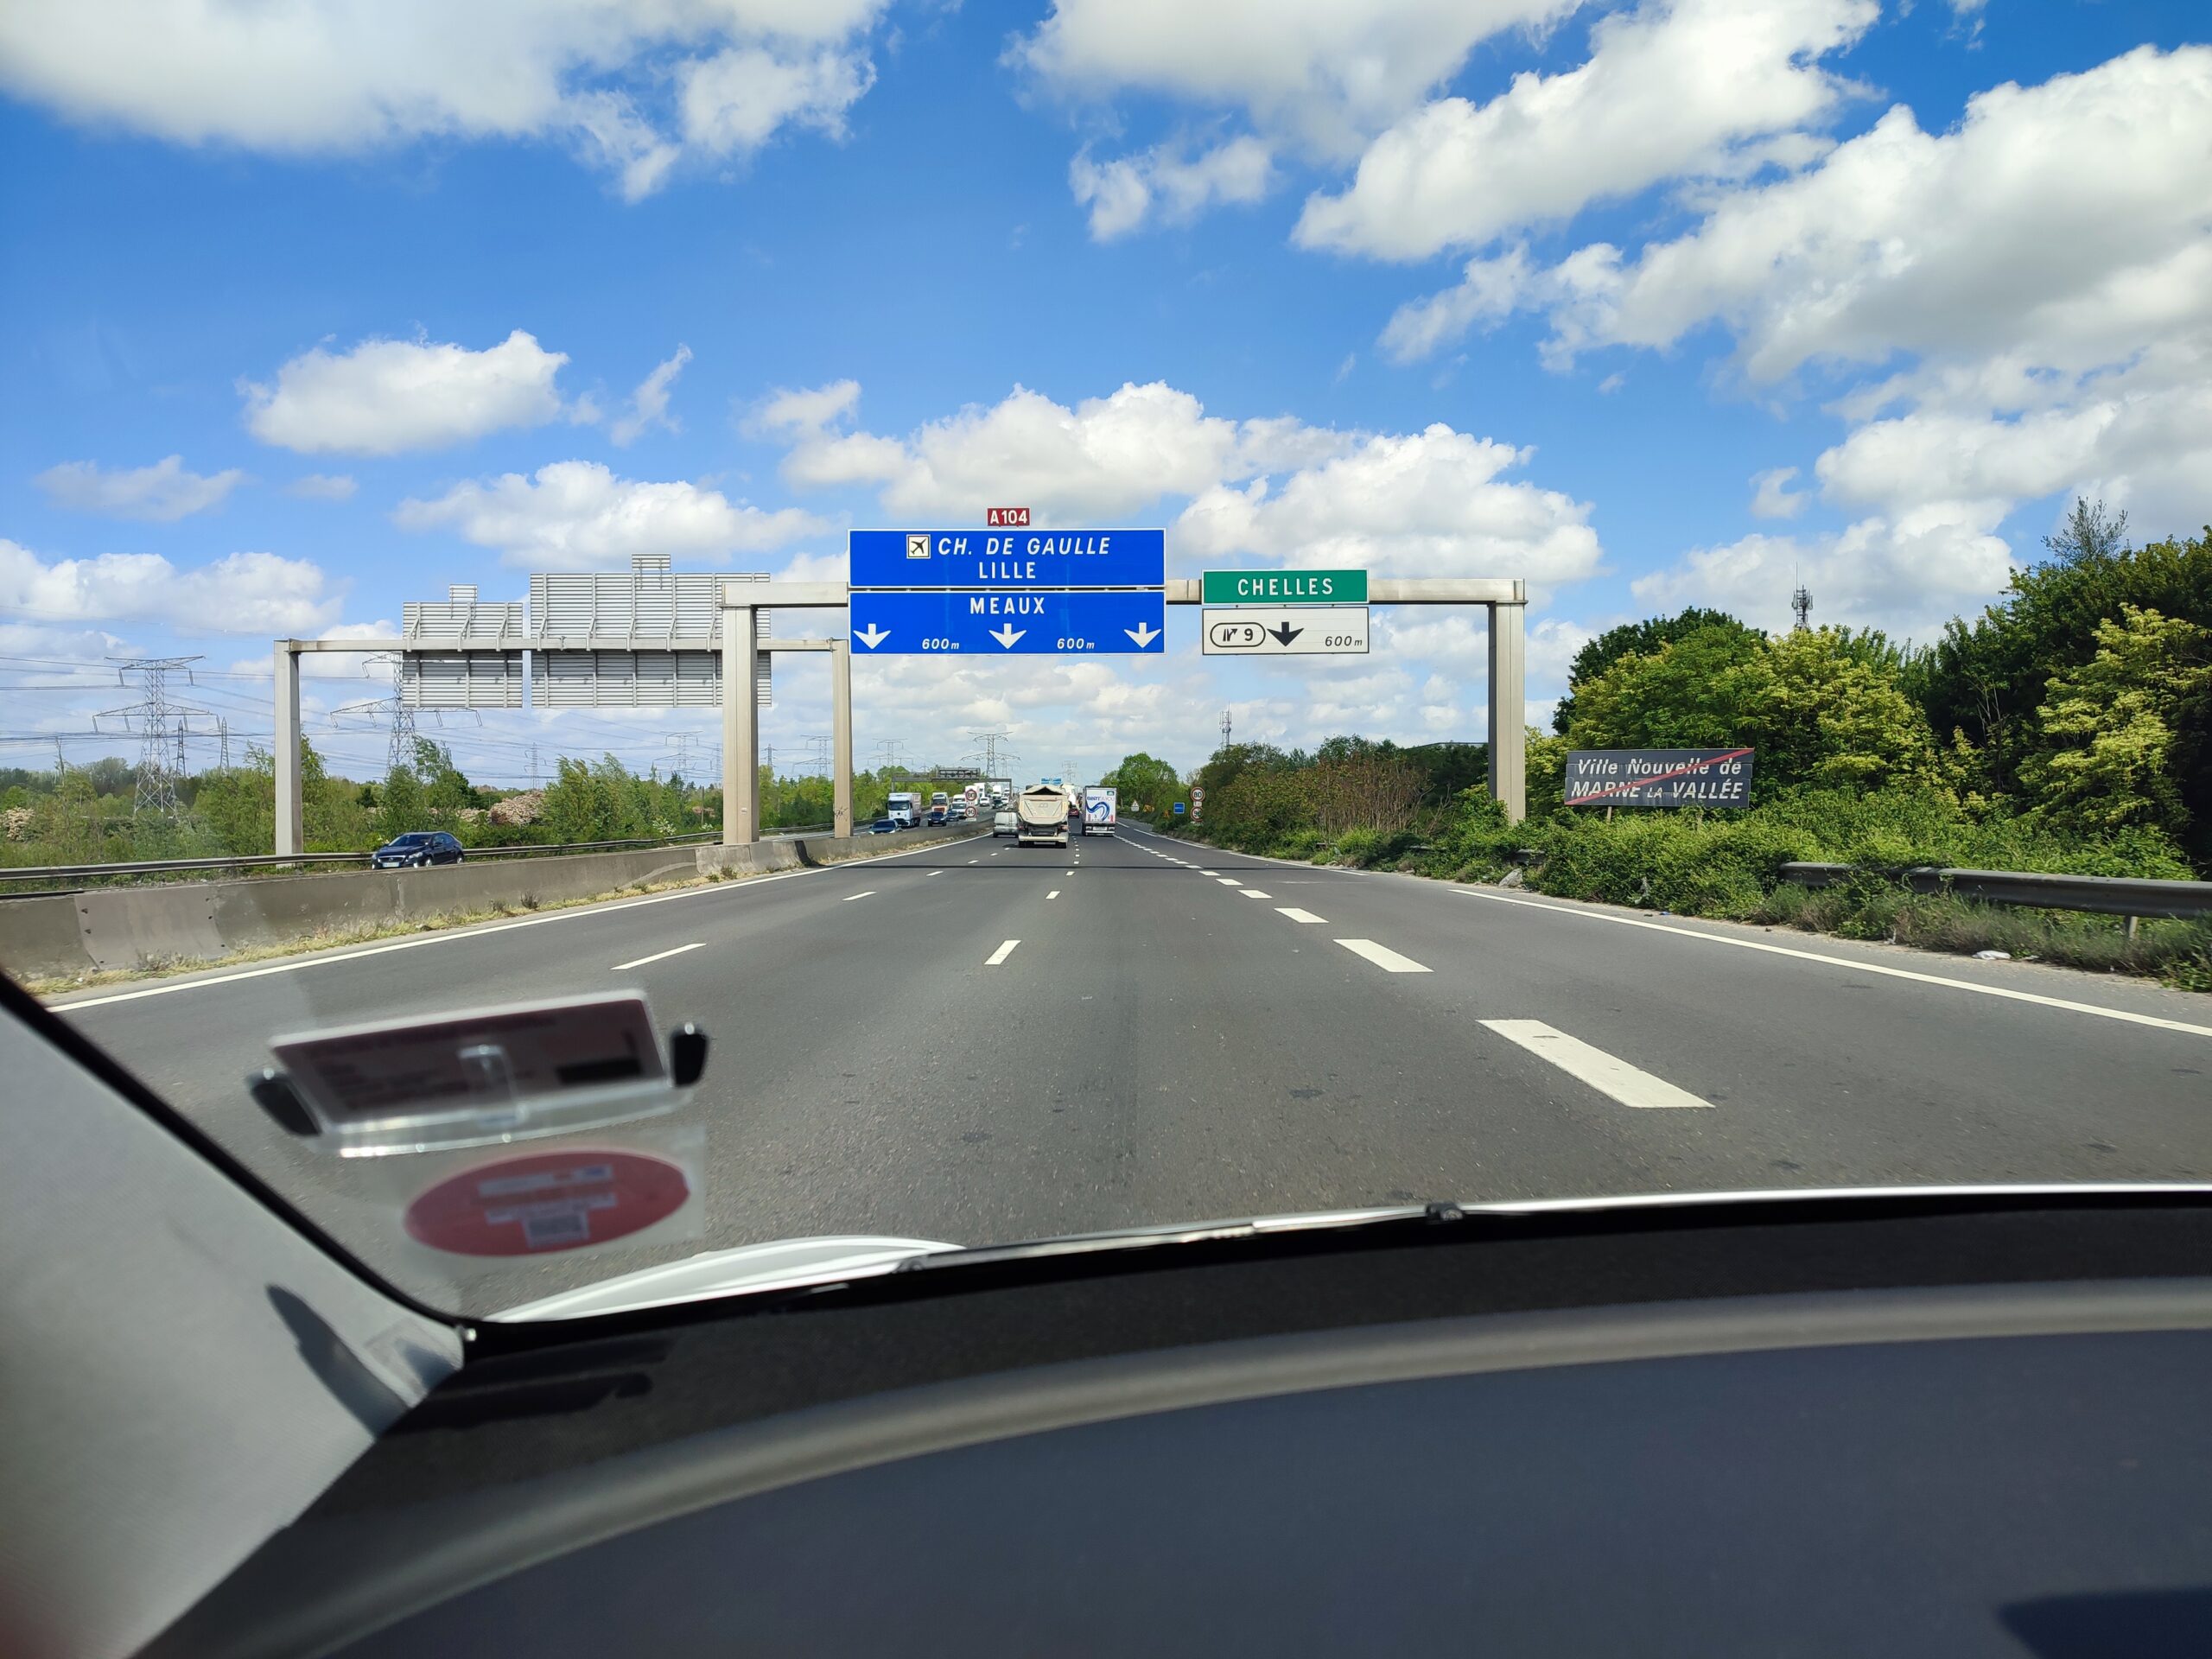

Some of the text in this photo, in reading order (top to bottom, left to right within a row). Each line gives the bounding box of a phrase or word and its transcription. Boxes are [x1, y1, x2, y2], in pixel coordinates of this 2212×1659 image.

[989, 510, 1028, 524] A104
[938, 537, 1111, 555] CH. DE GAULLE
[978, 562, 1036, 579] LILLE
[1237, 578, 1333, 596] CHELLES
[969, 597, 1045, 614] MEAUX
[1243, 628, 1254, 642] 9
[1577, 757, 1742, 775] Ville Nouvelle de
[1571, 779, 1744, 799] MARNE LA VALLÉE
